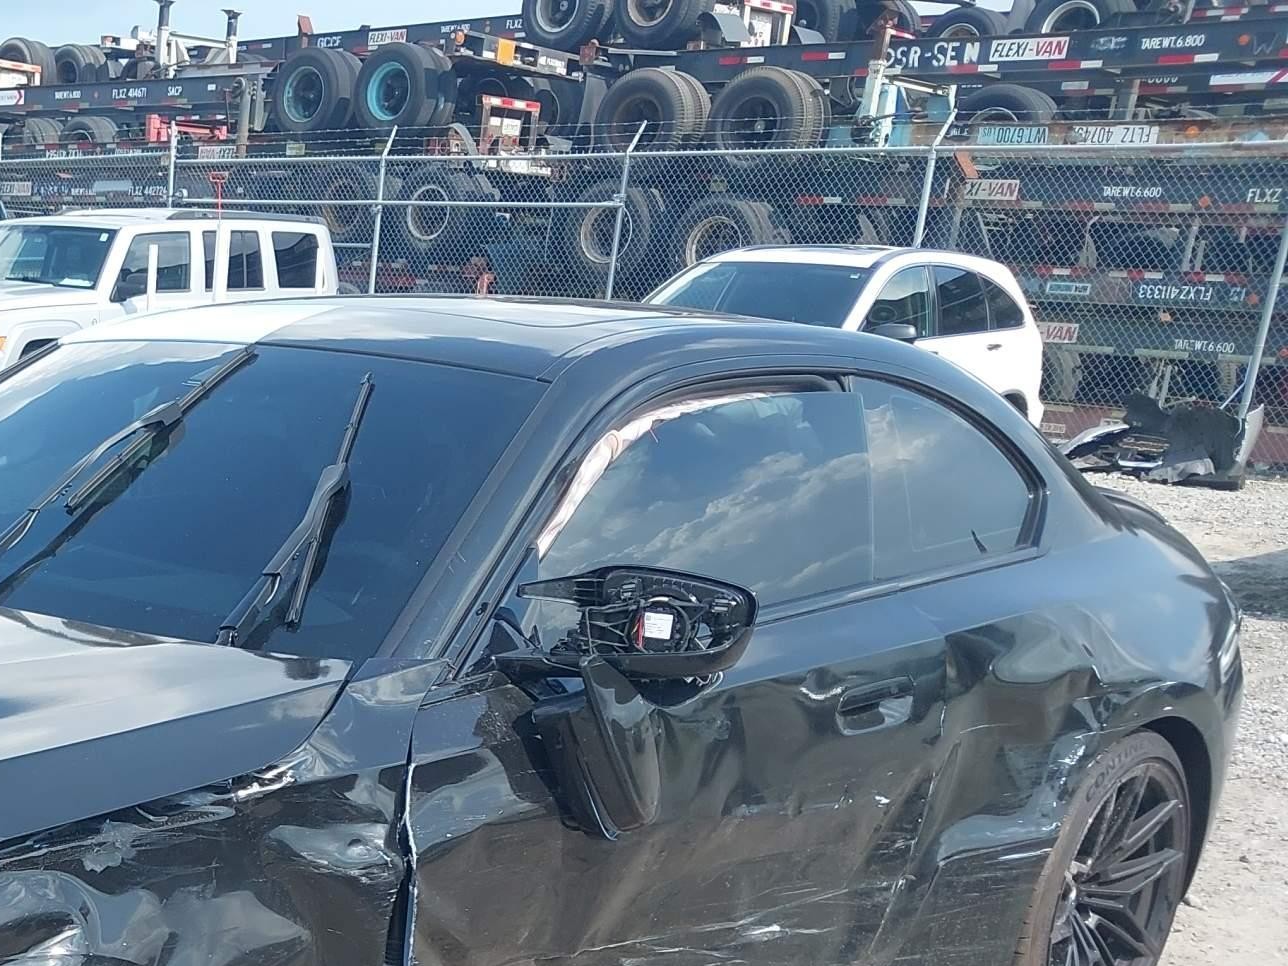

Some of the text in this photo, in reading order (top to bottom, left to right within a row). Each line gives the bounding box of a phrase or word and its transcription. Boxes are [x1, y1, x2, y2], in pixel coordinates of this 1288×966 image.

[369, 30, 406, 46] FLEXI-VAN
[991, 39, 1065, 58] FLEXI-VAN
[1121, 127, 1152, 144] FLTZ
[1246, 188, 1283, 203] FLXZ
